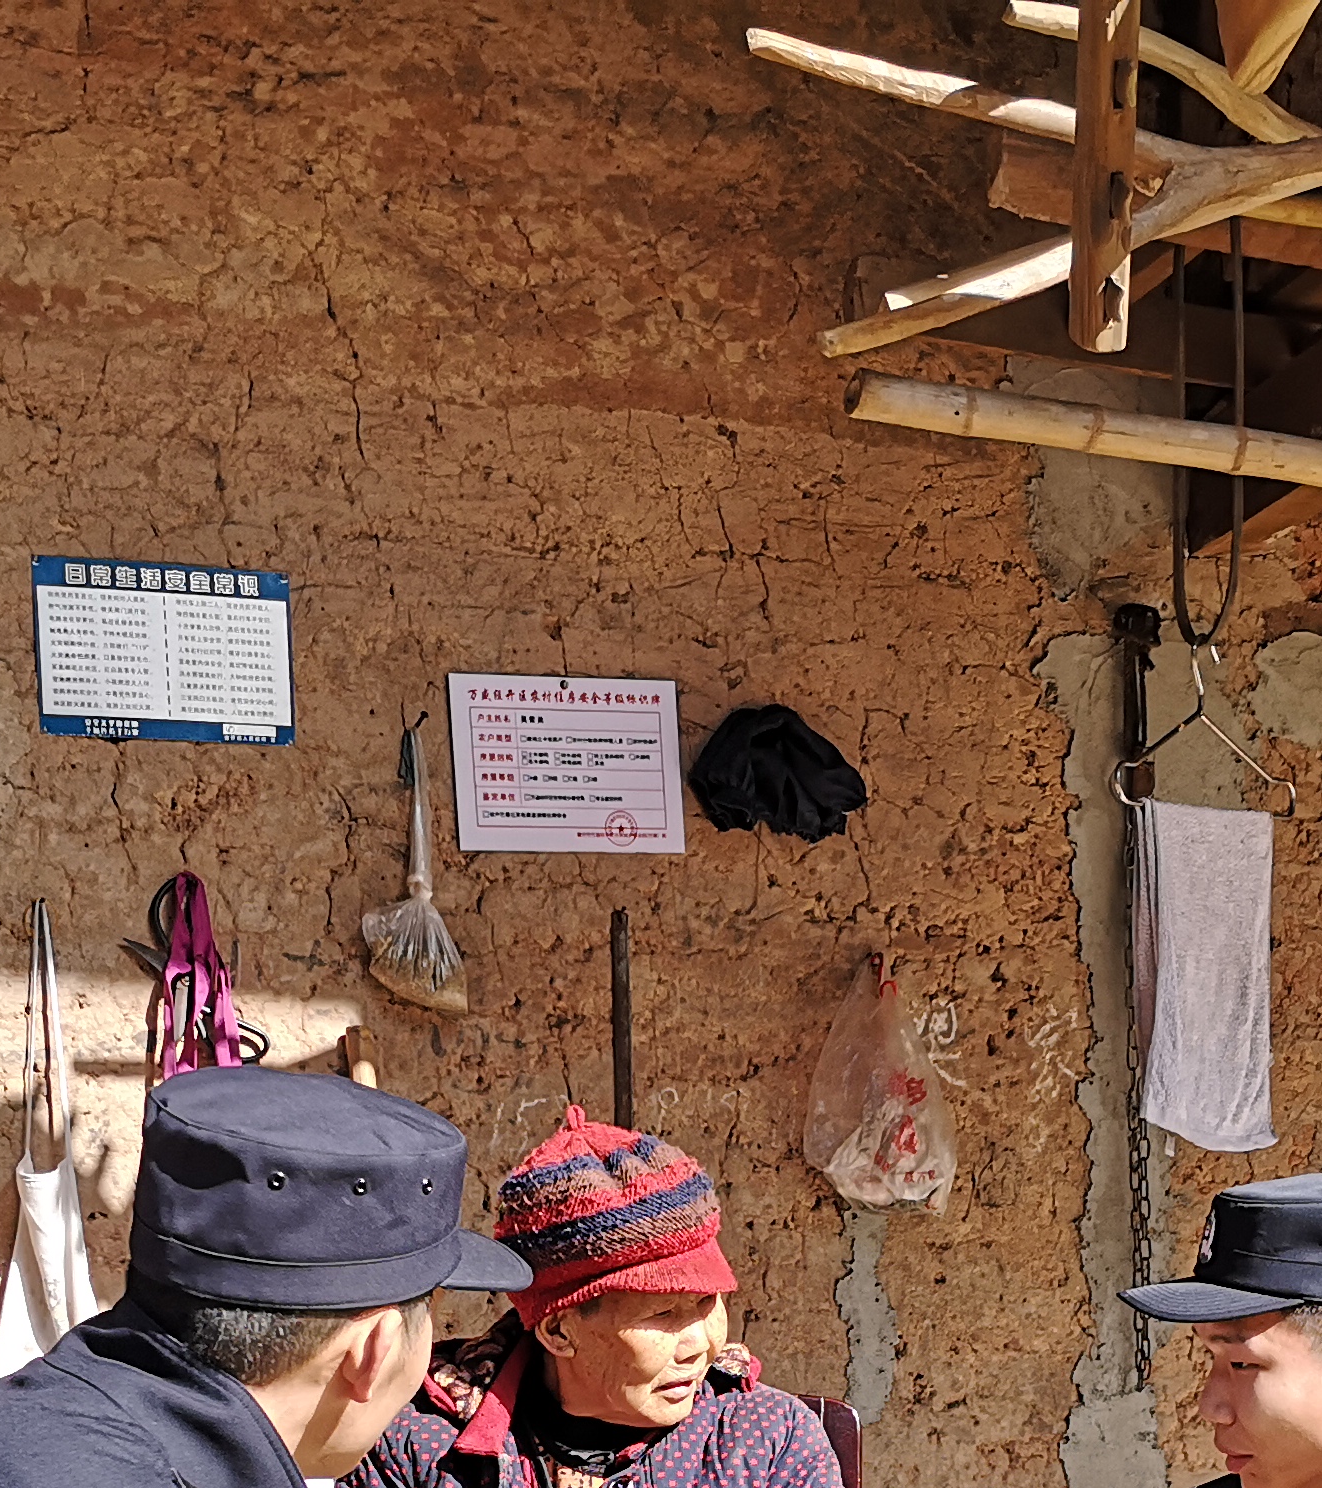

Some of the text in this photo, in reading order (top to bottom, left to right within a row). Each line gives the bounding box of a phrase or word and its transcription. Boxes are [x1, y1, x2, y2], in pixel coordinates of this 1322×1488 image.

[64, 563, 259, 596] 日常生活安全常识
[468, 688, 661, 706] 万盛经开区农村住房安全等级标识牌
